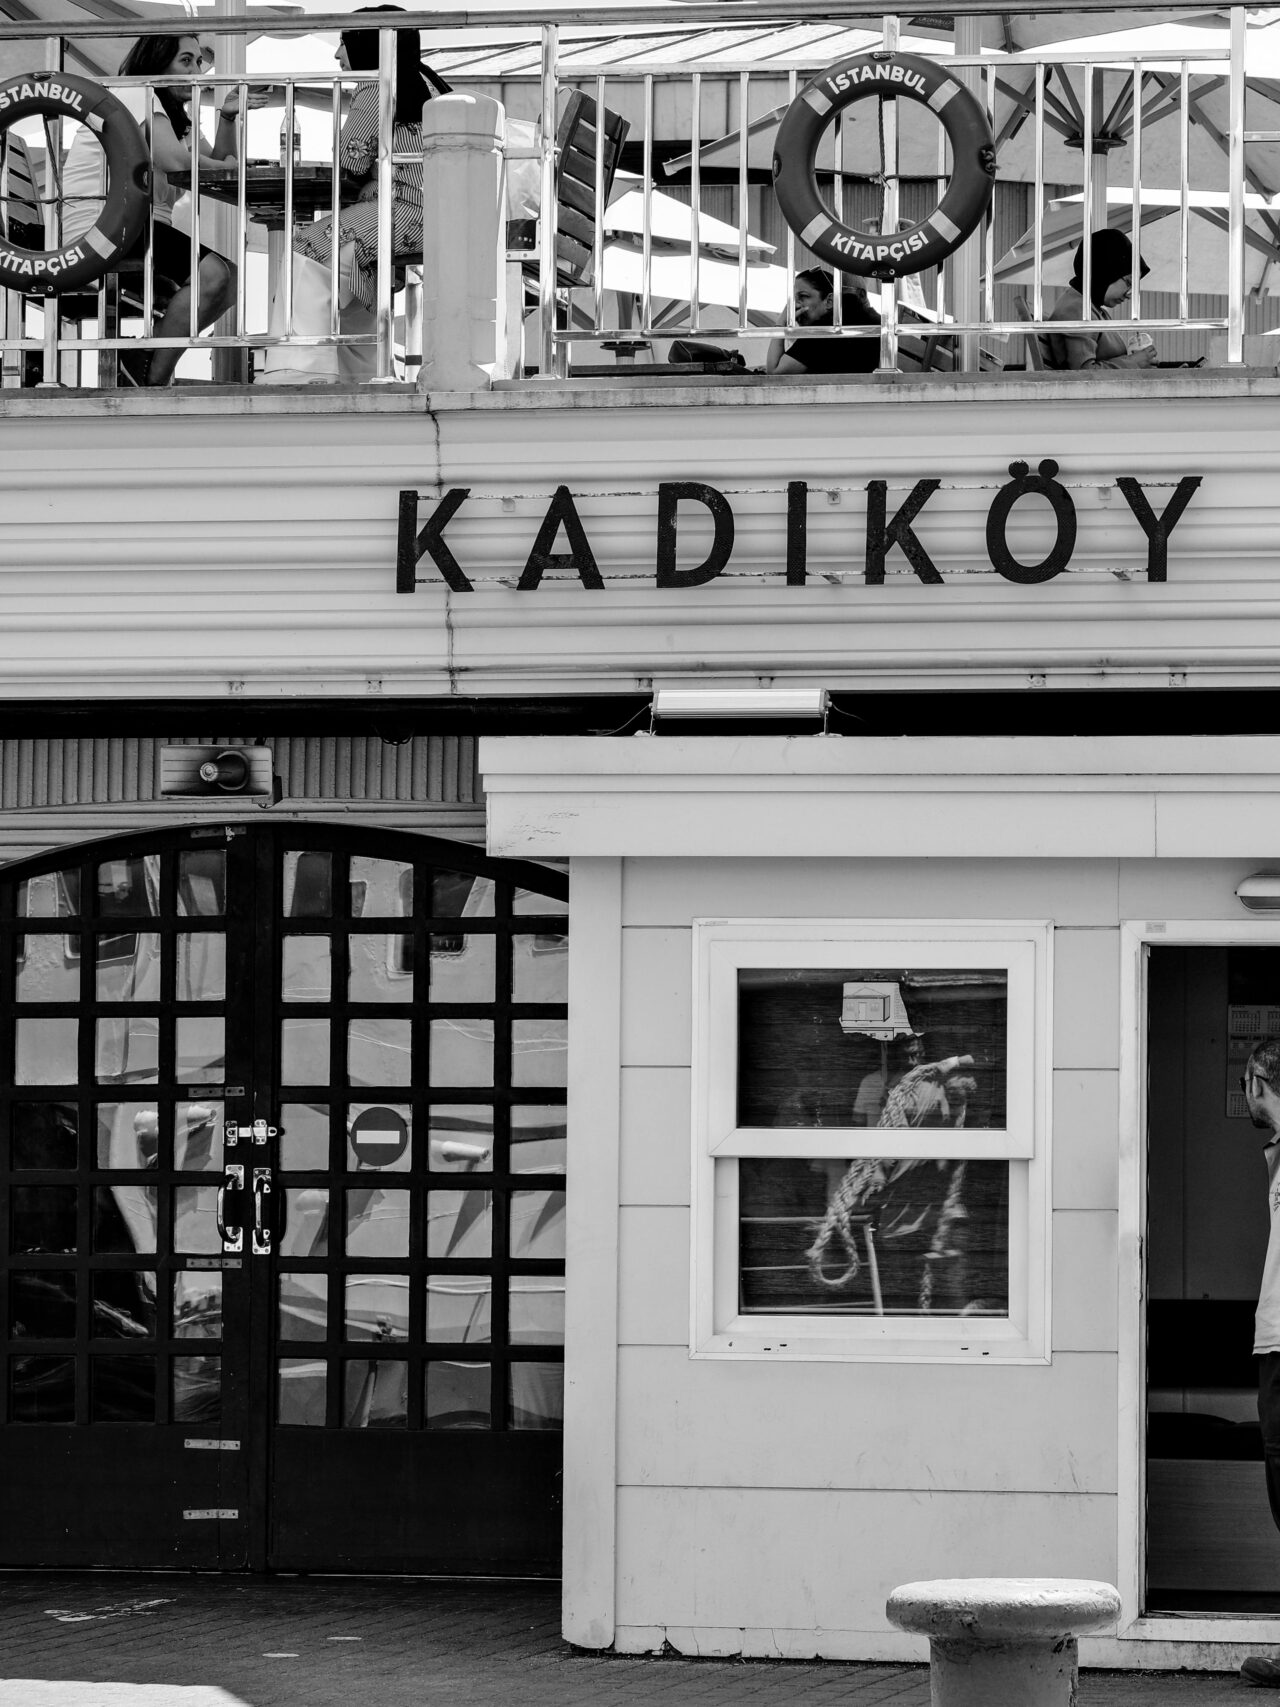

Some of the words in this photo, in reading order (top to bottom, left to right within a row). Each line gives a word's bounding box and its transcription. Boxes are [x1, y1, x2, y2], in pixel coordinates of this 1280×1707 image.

[825, 64, 928, 95] İSTANBUL
[0, 82, 83, 113] STANBUL
[830, 230, 930, 261] KİTAPÇISI
[396, 457, 1204, 594] KADIKÖY
